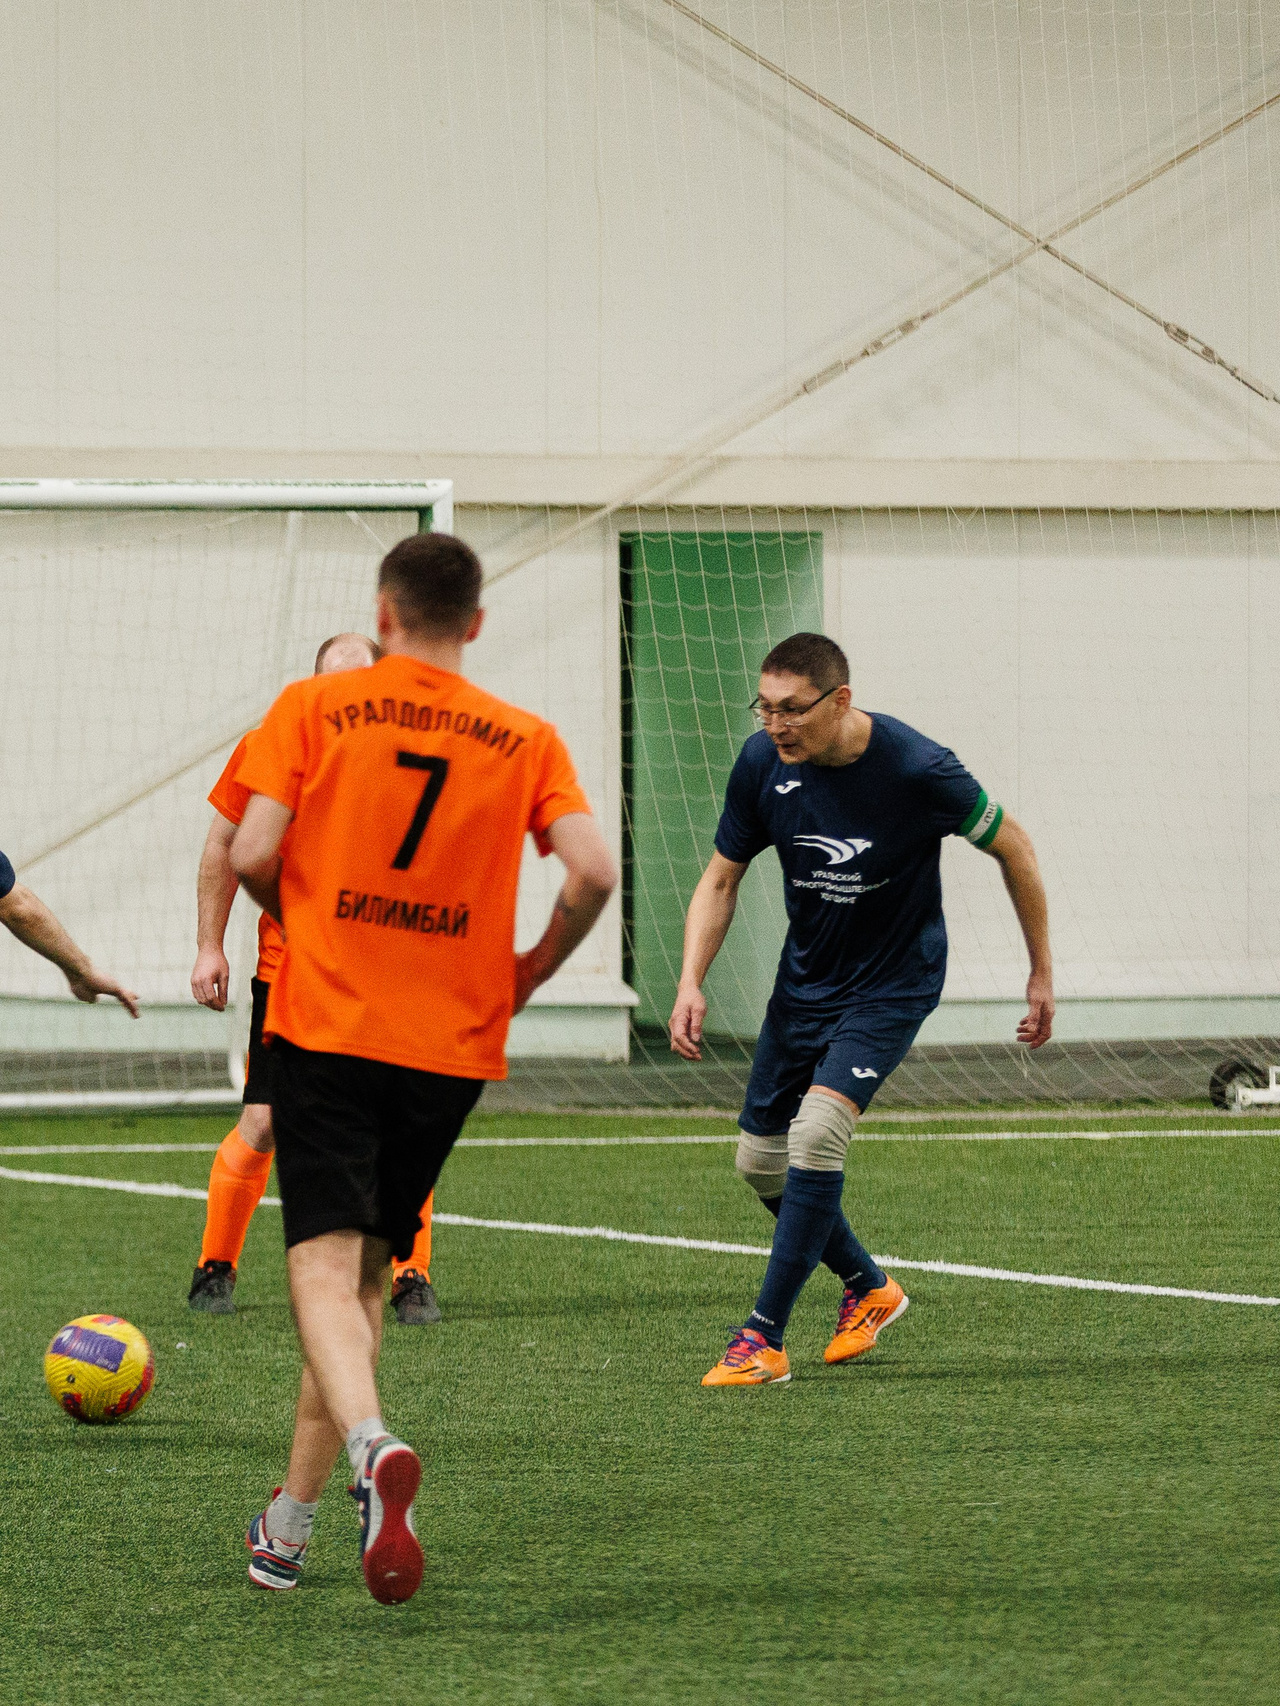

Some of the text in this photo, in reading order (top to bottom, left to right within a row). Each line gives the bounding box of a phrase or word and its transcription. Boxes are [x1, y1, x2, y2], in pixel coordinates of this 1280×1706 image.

[324, 698, 527, 758] УРАЛДОЛОМИТ
[391, 750, 449, 871] 7
[811, 870, 862, 881] УРАЛЬСКИЙ
[335, 889, 470, 938] БИЛИМБАЙ
